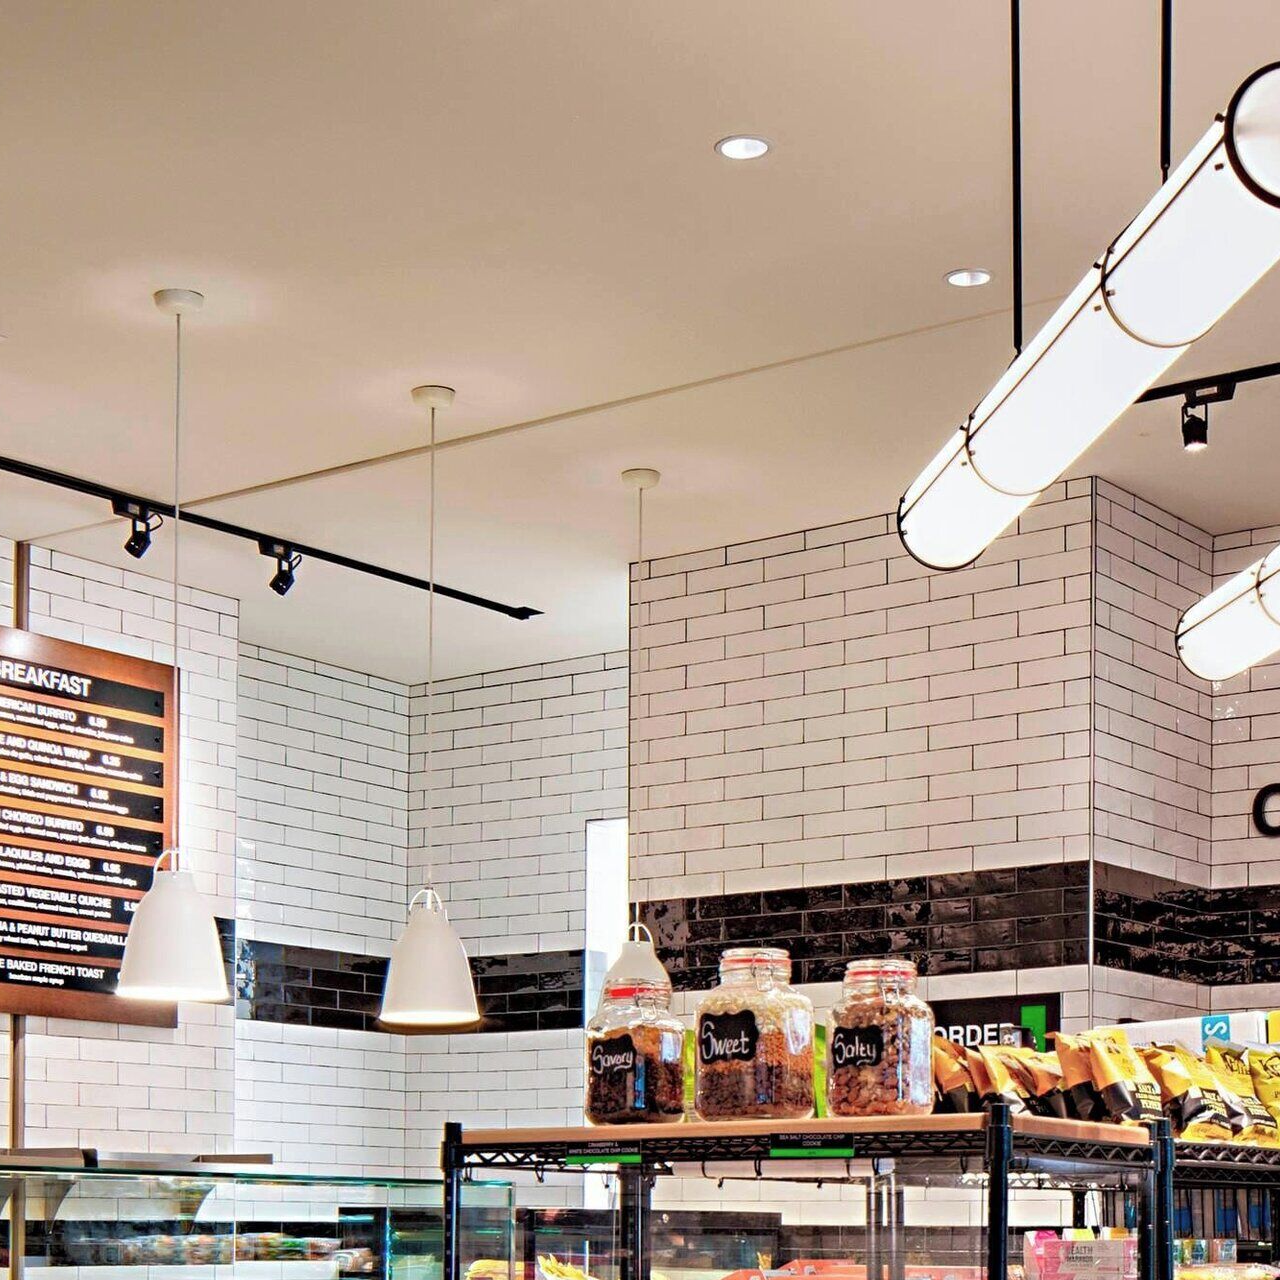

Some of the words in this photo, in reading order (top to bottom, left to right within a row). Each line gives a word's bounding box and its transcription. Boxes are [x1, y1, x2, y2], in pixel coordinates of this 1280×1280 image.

[27, 887, 76, 904] VEGETABLE
[78, 894, 112, 909] QUICHE
[9, 918, 16, 933] &
[18, 923, 50, 937] PEANUT
[51, 927, 81, 941] BUTTER
[7, 959, 37, 972] BAKED
[39, 963, 75, 976] FRENCH
[76, 968, 105, 979] TOAST
[701, 1021, 750, 1058] Sweet
[834, 1033, 877, 1066] Salty
[592, 1044, 635, 1074] Savory
